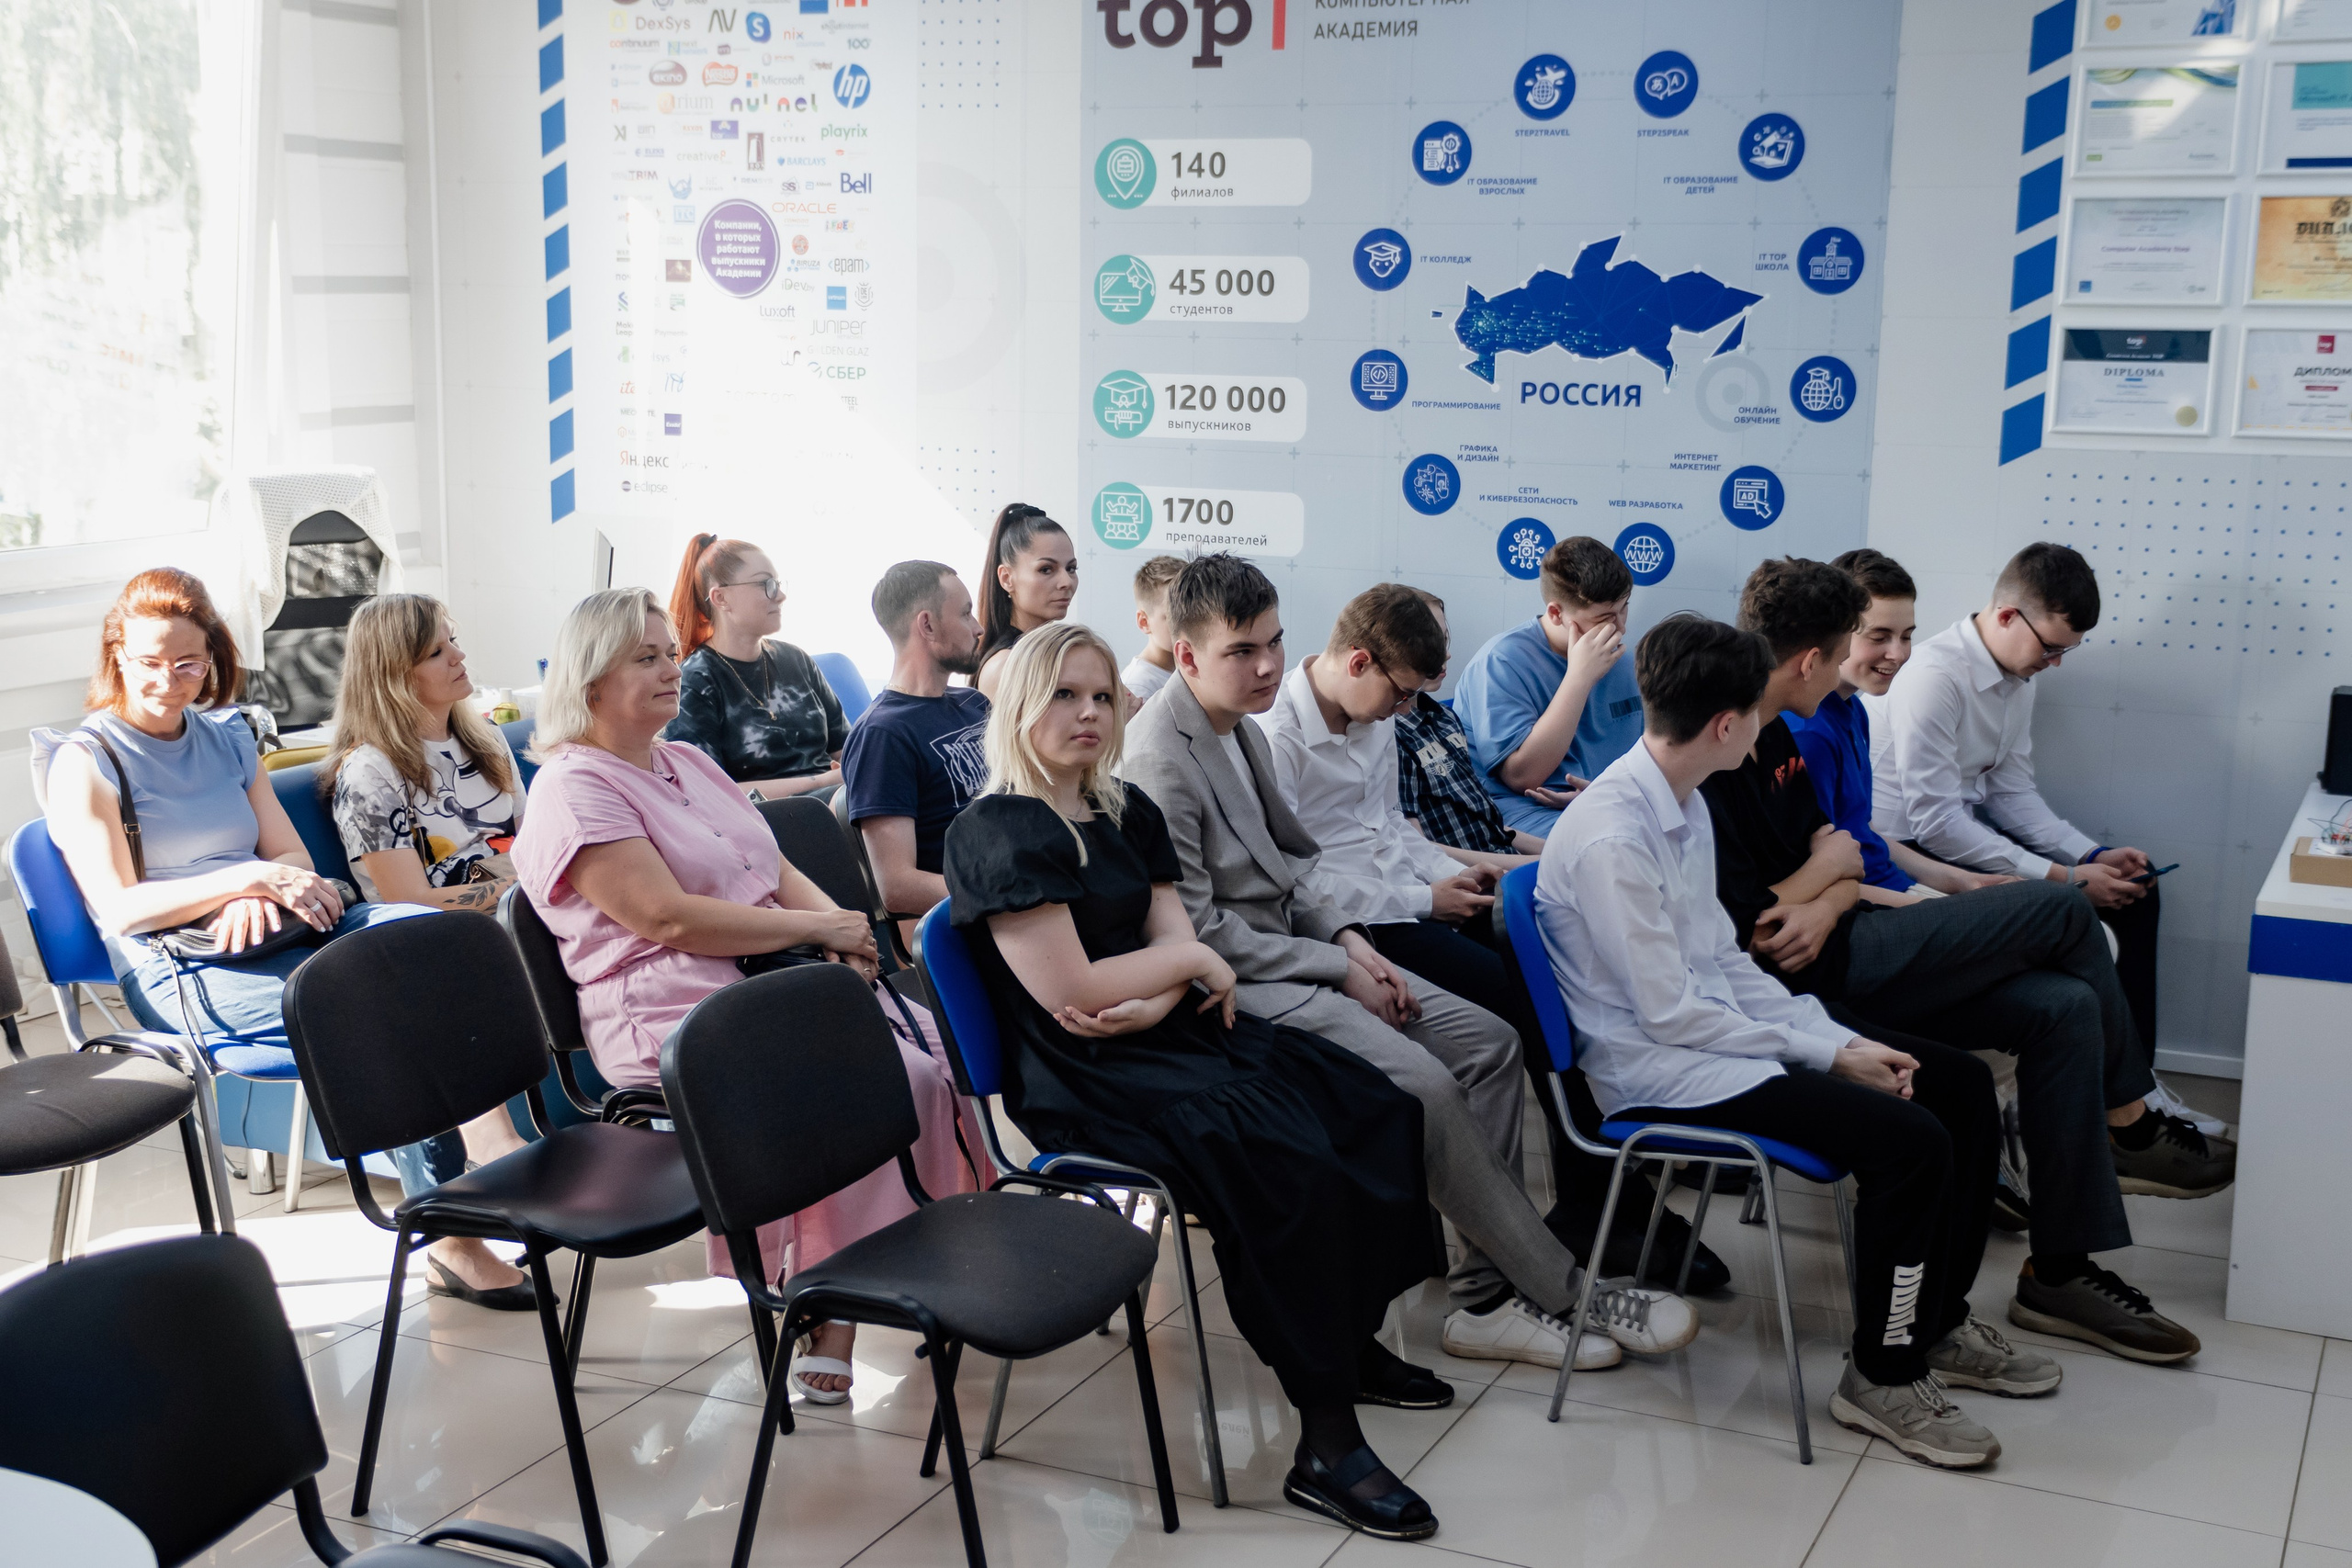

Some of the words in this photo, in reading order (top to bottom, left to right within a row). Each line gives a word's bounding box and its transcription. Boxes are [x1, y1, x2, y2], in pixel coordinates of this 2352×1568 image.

[1316, 0, 1470, 9] КОМПЬЮ
[636, 15, 691, 33] DexSys
[784, 28, 804, 40] nix
[1097, 0, 1252, 69] top
[1314, 20, 1419, 41] АКАДЕМИЯ
[762, 74, 805, 85] Microsoft
[821, 124, 867, 141] playrix
[1514, 129, 1570, 137] STEP2TRAVEL
[1637, 129, 1690, 138] STEP2SPEAK
[787, 157, 826, 166] BARCLAYS
[1170, 152, 1227, 179] 140
[840, 173, 872, 194] Bell
[1476, 177, 1537, 186] ОБРАЗОВАНИЕ
[1663, 176, 1671, 185] IT
[1673, 175, 1738, 185] ОБРАЗОВАНИЕ
[1170, 186, 1234, 200] филиалов
[1479, 187, 1525, 196] ВЗРОСЛЫХ
[1685, 185, 1714, 196] ДЕТЕЙ
[772, 202, 837, 214] ORACLE
[715, 220, 762, 231] Компании,
[716, 233, 721, 242] в
[723, 233, 761, 243] которых
[717, 244, 760, 254] работают
[711, 257, 765, 267] выпускники
[1430, 255, 1472, 265] КОЛЛЕДЖ
[716, 267, 762, 278] Академии
[1755, 263, 1790, 271] ШКОЛА
[1169, 269, 1205, 296] 45
[1215, 269, 1275, 297] 000
[760, 305, 796, 318] Luxoft
[1170, 304, 1234, 317] студентов
[808, 345, 843, 355] GLDEN
[827, 367, 866, 379] СБЕР
[2103, 368, 2165, 377] DIPLOMA
[2293, 367, 2352, 378] ДИПЛОМ
[1164, 384, 1216, 412] 120
[1227, 386, 1286, 413] 000
[1521, 382, 1642, 407] РОССИЯ
[1411, 400, 1501, 411] ПРОГРАММИРОВАНИЕ
[1738, 406, 1777, 414] ОНЛАЙН
[1734, 416, 1781, 424] ОБУЧЕНИЕ
[1168, 420, 1251, 434] выпускников
[1459, 444, 1498, 453] ГРАФИКА
[1464, 454, 1499, 462] ДИЗАЙН
[1674, 453, 1718, 461] ИНТЕРНЕТ
[1669, 463, 1721, 471] МАРКЕТИНГ
[634, 481, 668, 494] eclipse
[1487, 494, 1578, 506] КИБЕРБЕЗОПАСНОСТЬ
[1608, 500, 1626, 508] WEB
[1628, 500, 1683, 510] РАЗРАБОТКА
[1162, 497, 1234, 525] 1700
[1166, 532, 1267, 547] преподавателей
[1883, 1261, 1924, 1346] PUMA
